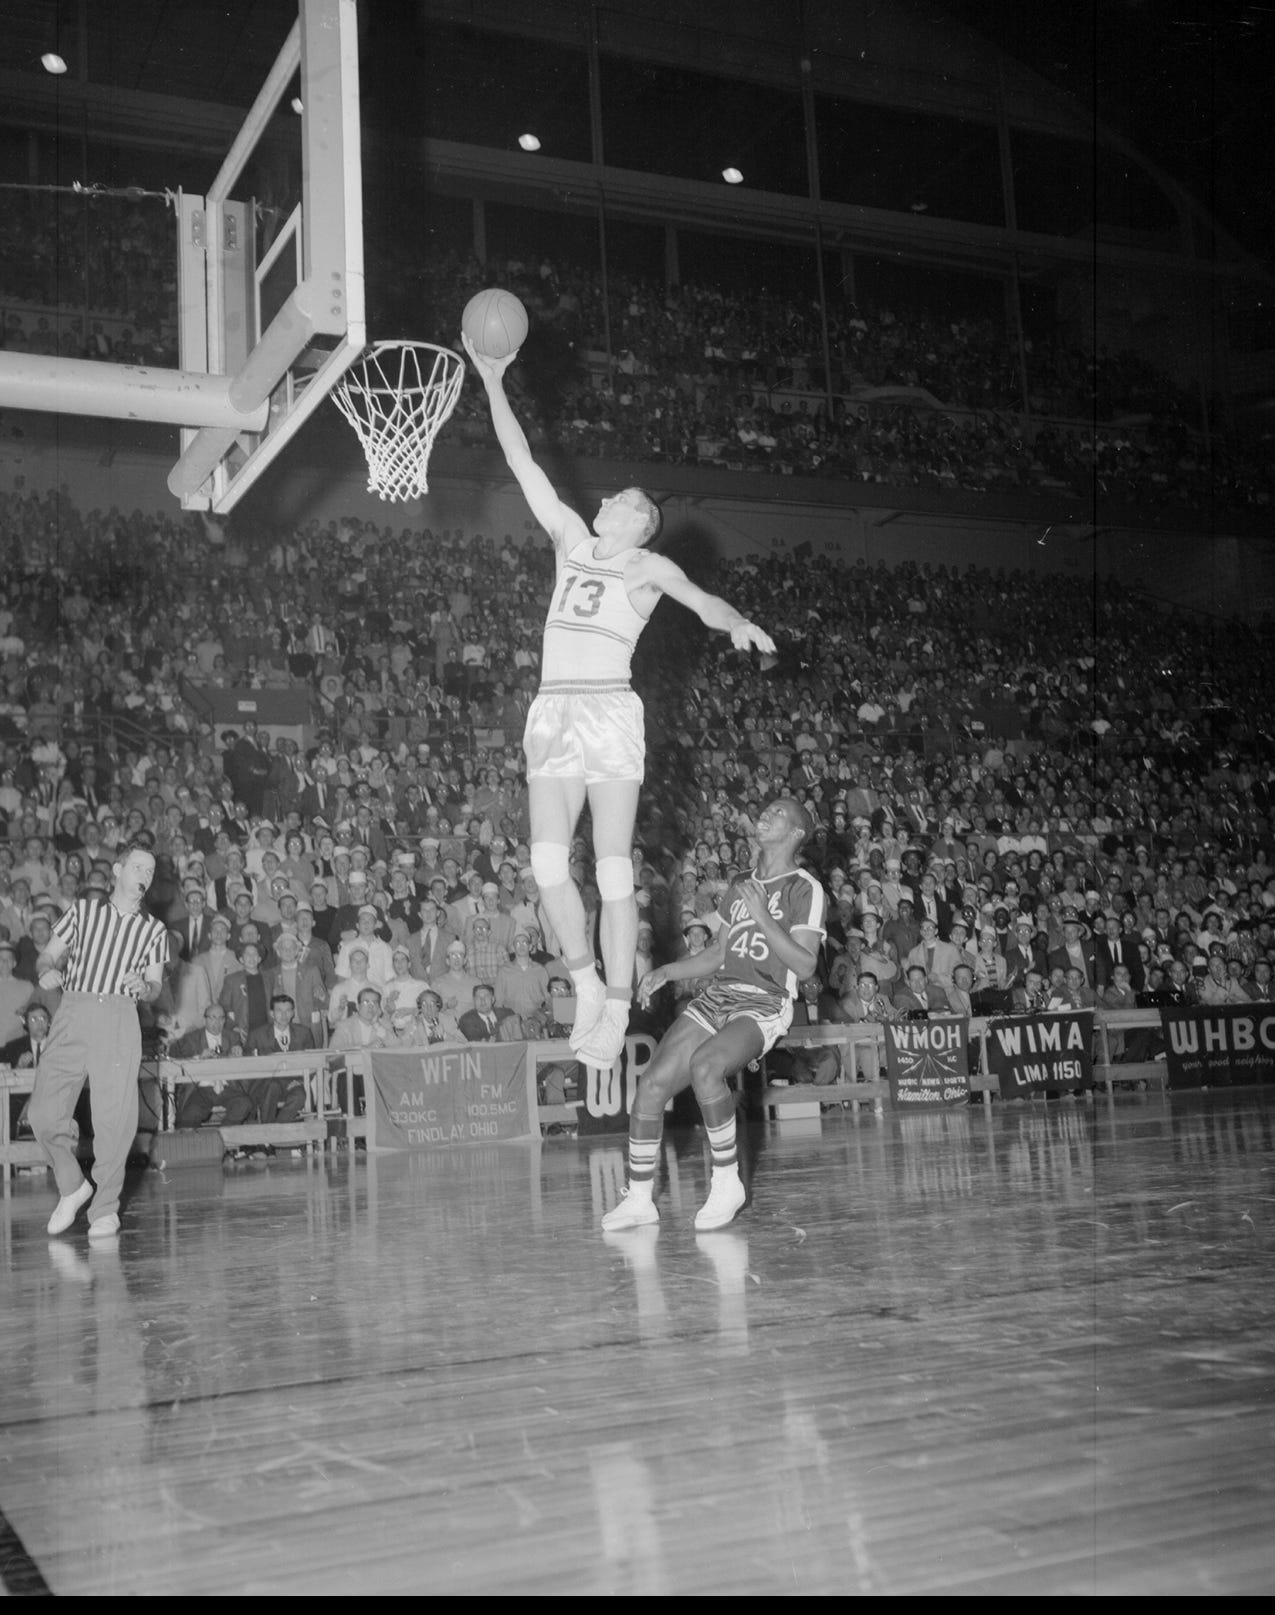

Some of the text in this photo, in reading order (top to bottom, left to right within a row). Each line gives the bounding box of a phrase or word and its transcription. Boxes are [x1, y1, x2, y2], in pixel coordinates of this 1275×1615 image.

[558, 576, 606, 618] 13
[731, 931, 769, 961] 45
[890, 1024, 961, 1050] WMOH
[996, 1021, 1084, 1056] WIMA
[420, 1052, 482, 1085] WFIN
[1013, 1060, 1082, 1086] LIMA 1150
[399, 1091, 424, 1106] AM
[480, 1083, 503, 1099] FM
[943, 1086, 968, 1100] Ohio
[470, 1121, 499, 1137] OHIO
